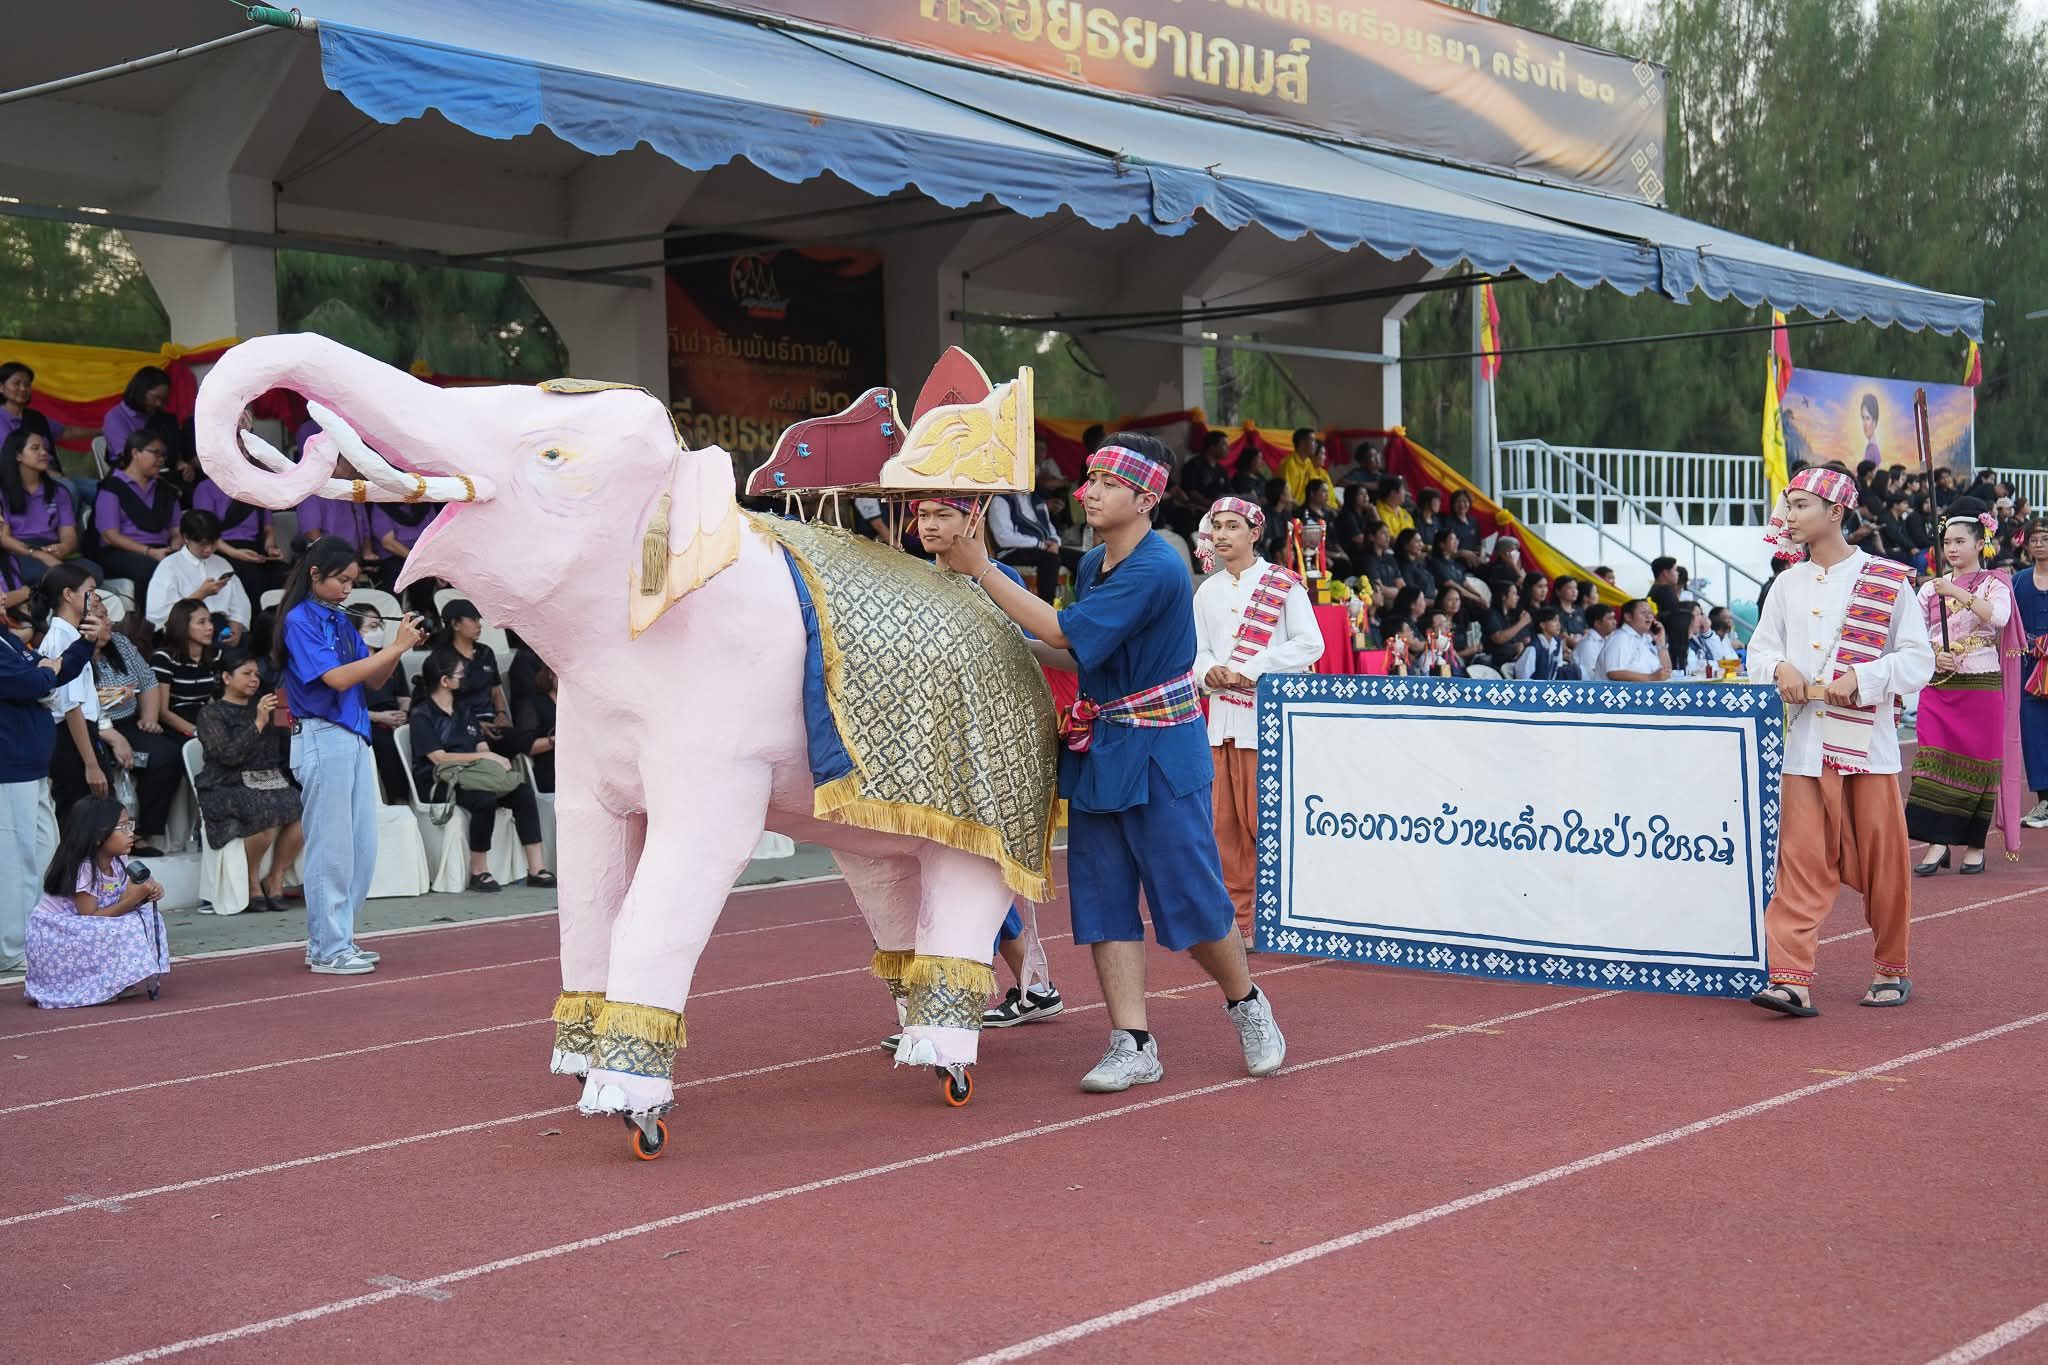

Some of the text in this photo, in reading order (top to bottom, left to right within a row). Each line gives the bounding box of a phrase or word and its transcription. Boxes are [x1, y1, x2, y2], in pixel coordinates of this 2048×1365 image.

[1492, 40, 1567, 93] ครั้งที่
[1576, 73, 1616, 103] ๒๐
[1304, 794, 1735, 866] โครงการบ้านเล็กในป่าใหญ่
